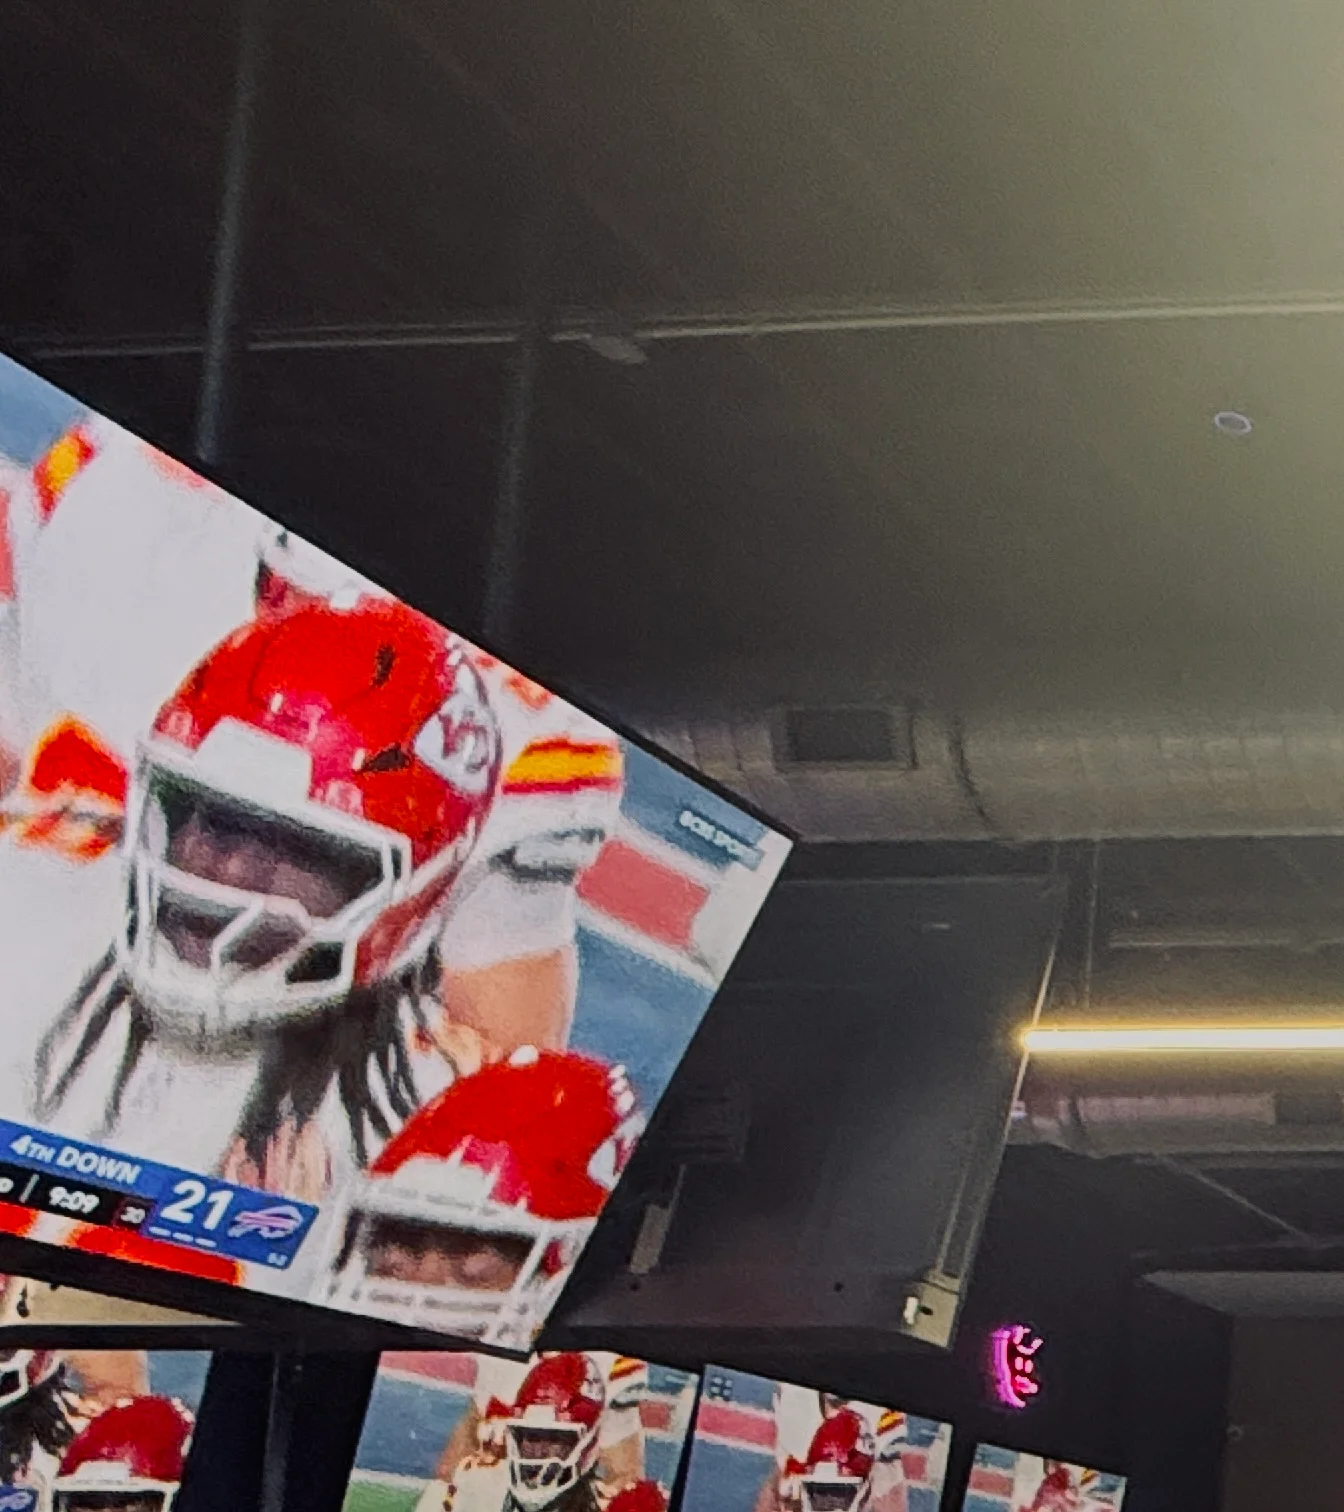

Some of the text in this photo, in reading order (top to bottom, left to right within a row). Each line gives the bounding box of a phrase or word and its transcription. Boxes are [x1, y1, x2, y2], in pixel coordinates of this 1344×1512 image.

[9, 1134, 142, 1186] 4TH DOWN
[49, 1185, 101, 1214] 9:09
[160, 1179, 235, 1231] 21
